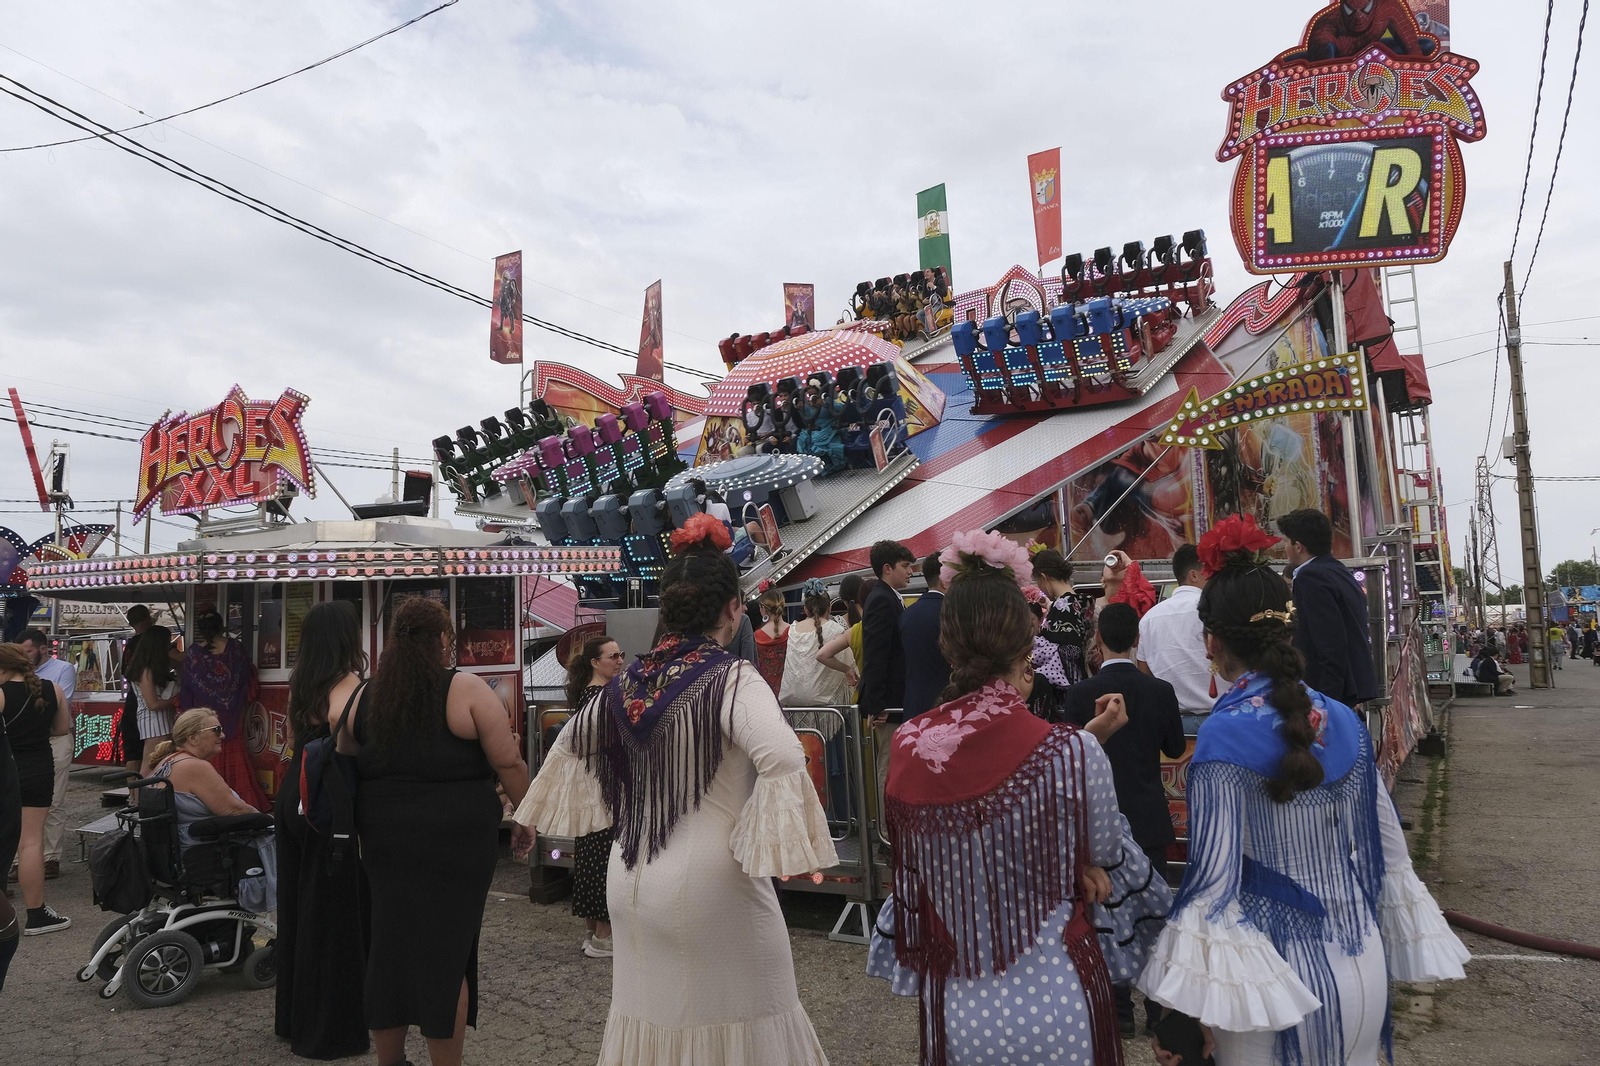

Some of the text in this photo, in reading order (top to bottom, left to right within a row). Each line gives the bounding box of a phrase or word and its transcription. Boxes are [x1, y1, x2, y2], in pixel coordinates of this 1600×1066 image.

[1233, 62, 1475, 146] HEROES
[1298, 169, 1365, 187] 6 7 8
[1320, 210, 1343, 220] RPM
[1218, 370, 1347, 418] ENTRADA
[133, 393, 308, 512] HEROES
[176, 462, 259, 507] XXL
[228, 911, 257, 919] MYKONOS
